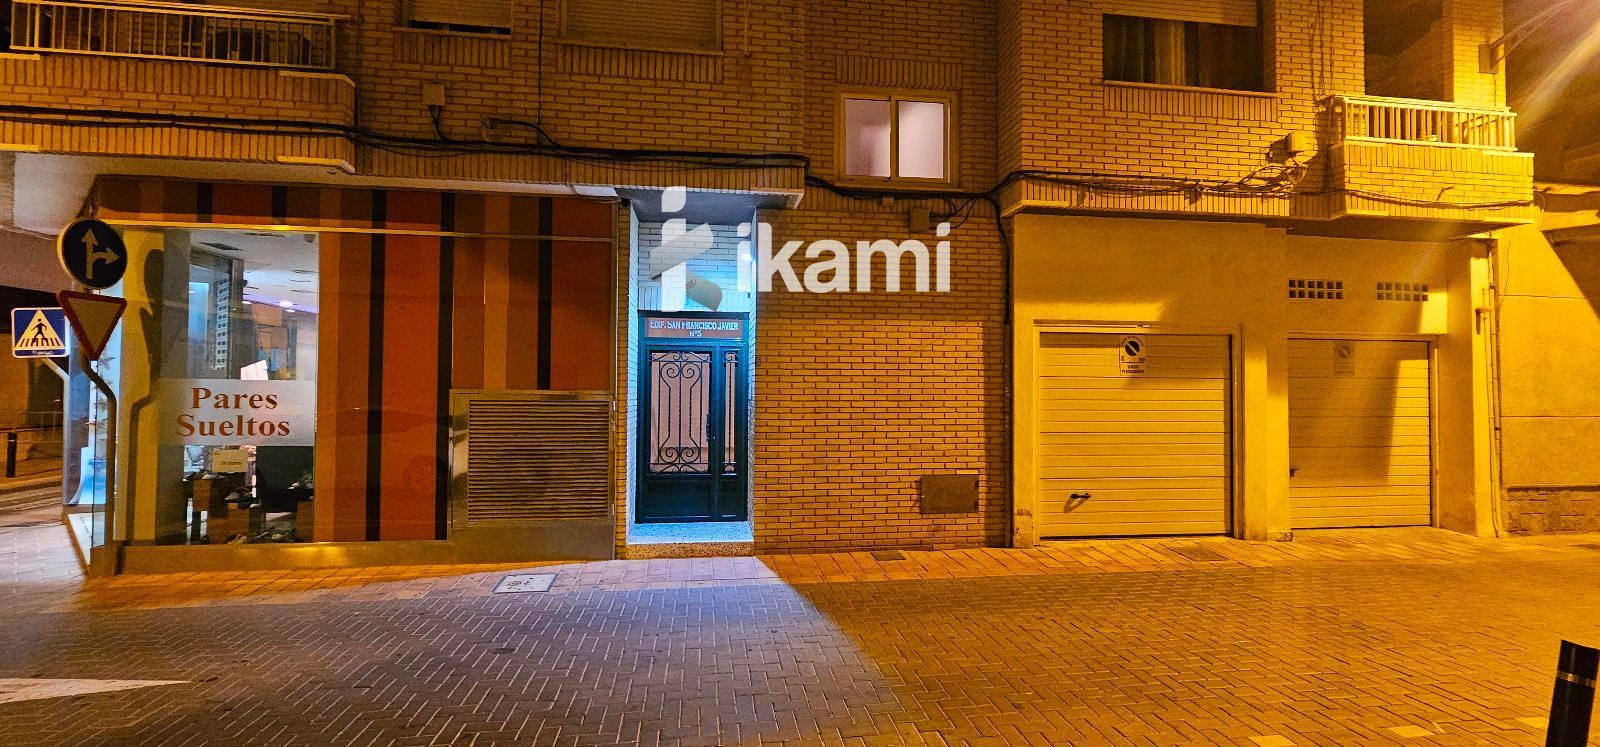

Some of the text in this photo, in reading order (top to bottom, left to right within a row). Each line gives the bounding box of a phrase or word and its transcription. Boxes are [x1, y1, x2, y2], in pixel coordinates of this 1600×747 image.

[650, 320, 739, 331] EDIF. SAN FRANCISCO JAVIER
[191, 387, 278, 409] Pares
[176, 414, 290, 436] Sueltos
